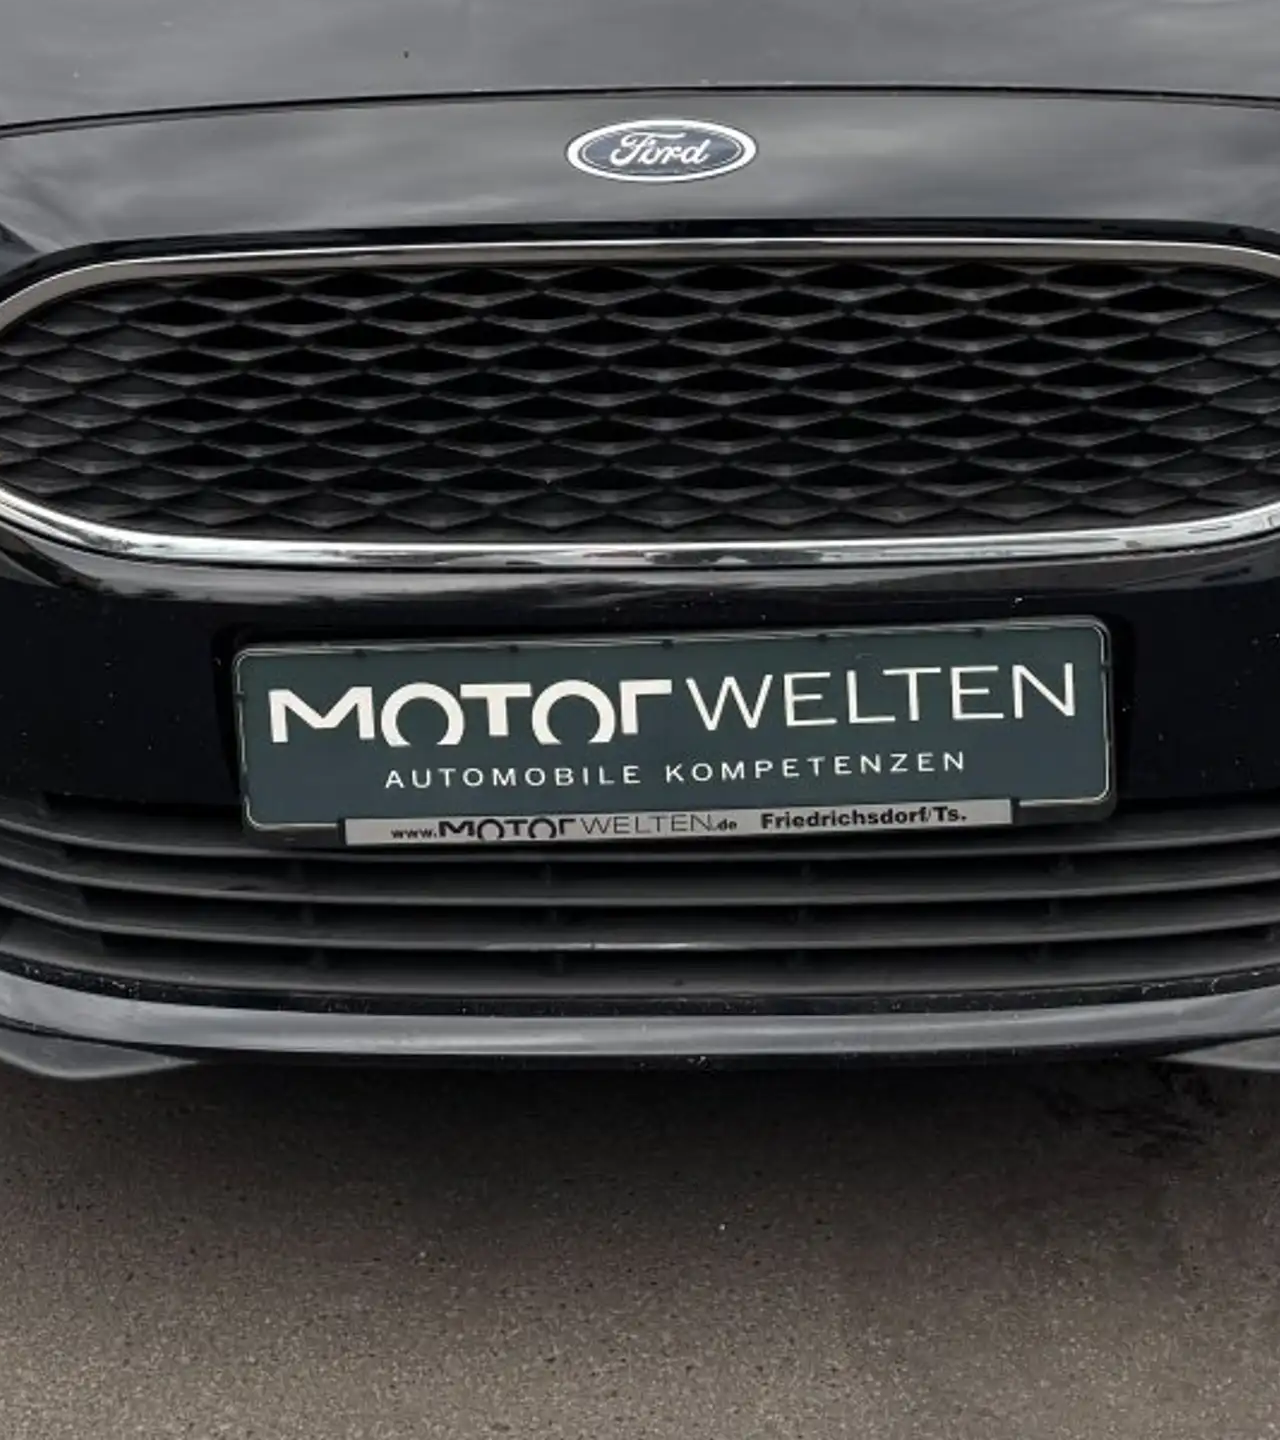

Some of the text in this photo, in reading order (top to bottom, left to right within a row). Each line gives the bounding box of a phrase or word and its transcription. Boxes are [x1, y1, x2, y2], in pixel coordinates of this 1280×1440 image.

[610, 131, 711, 166] Ford
[384, 751, 965, 790] AUTOMOBILE KOMPETENZEN
